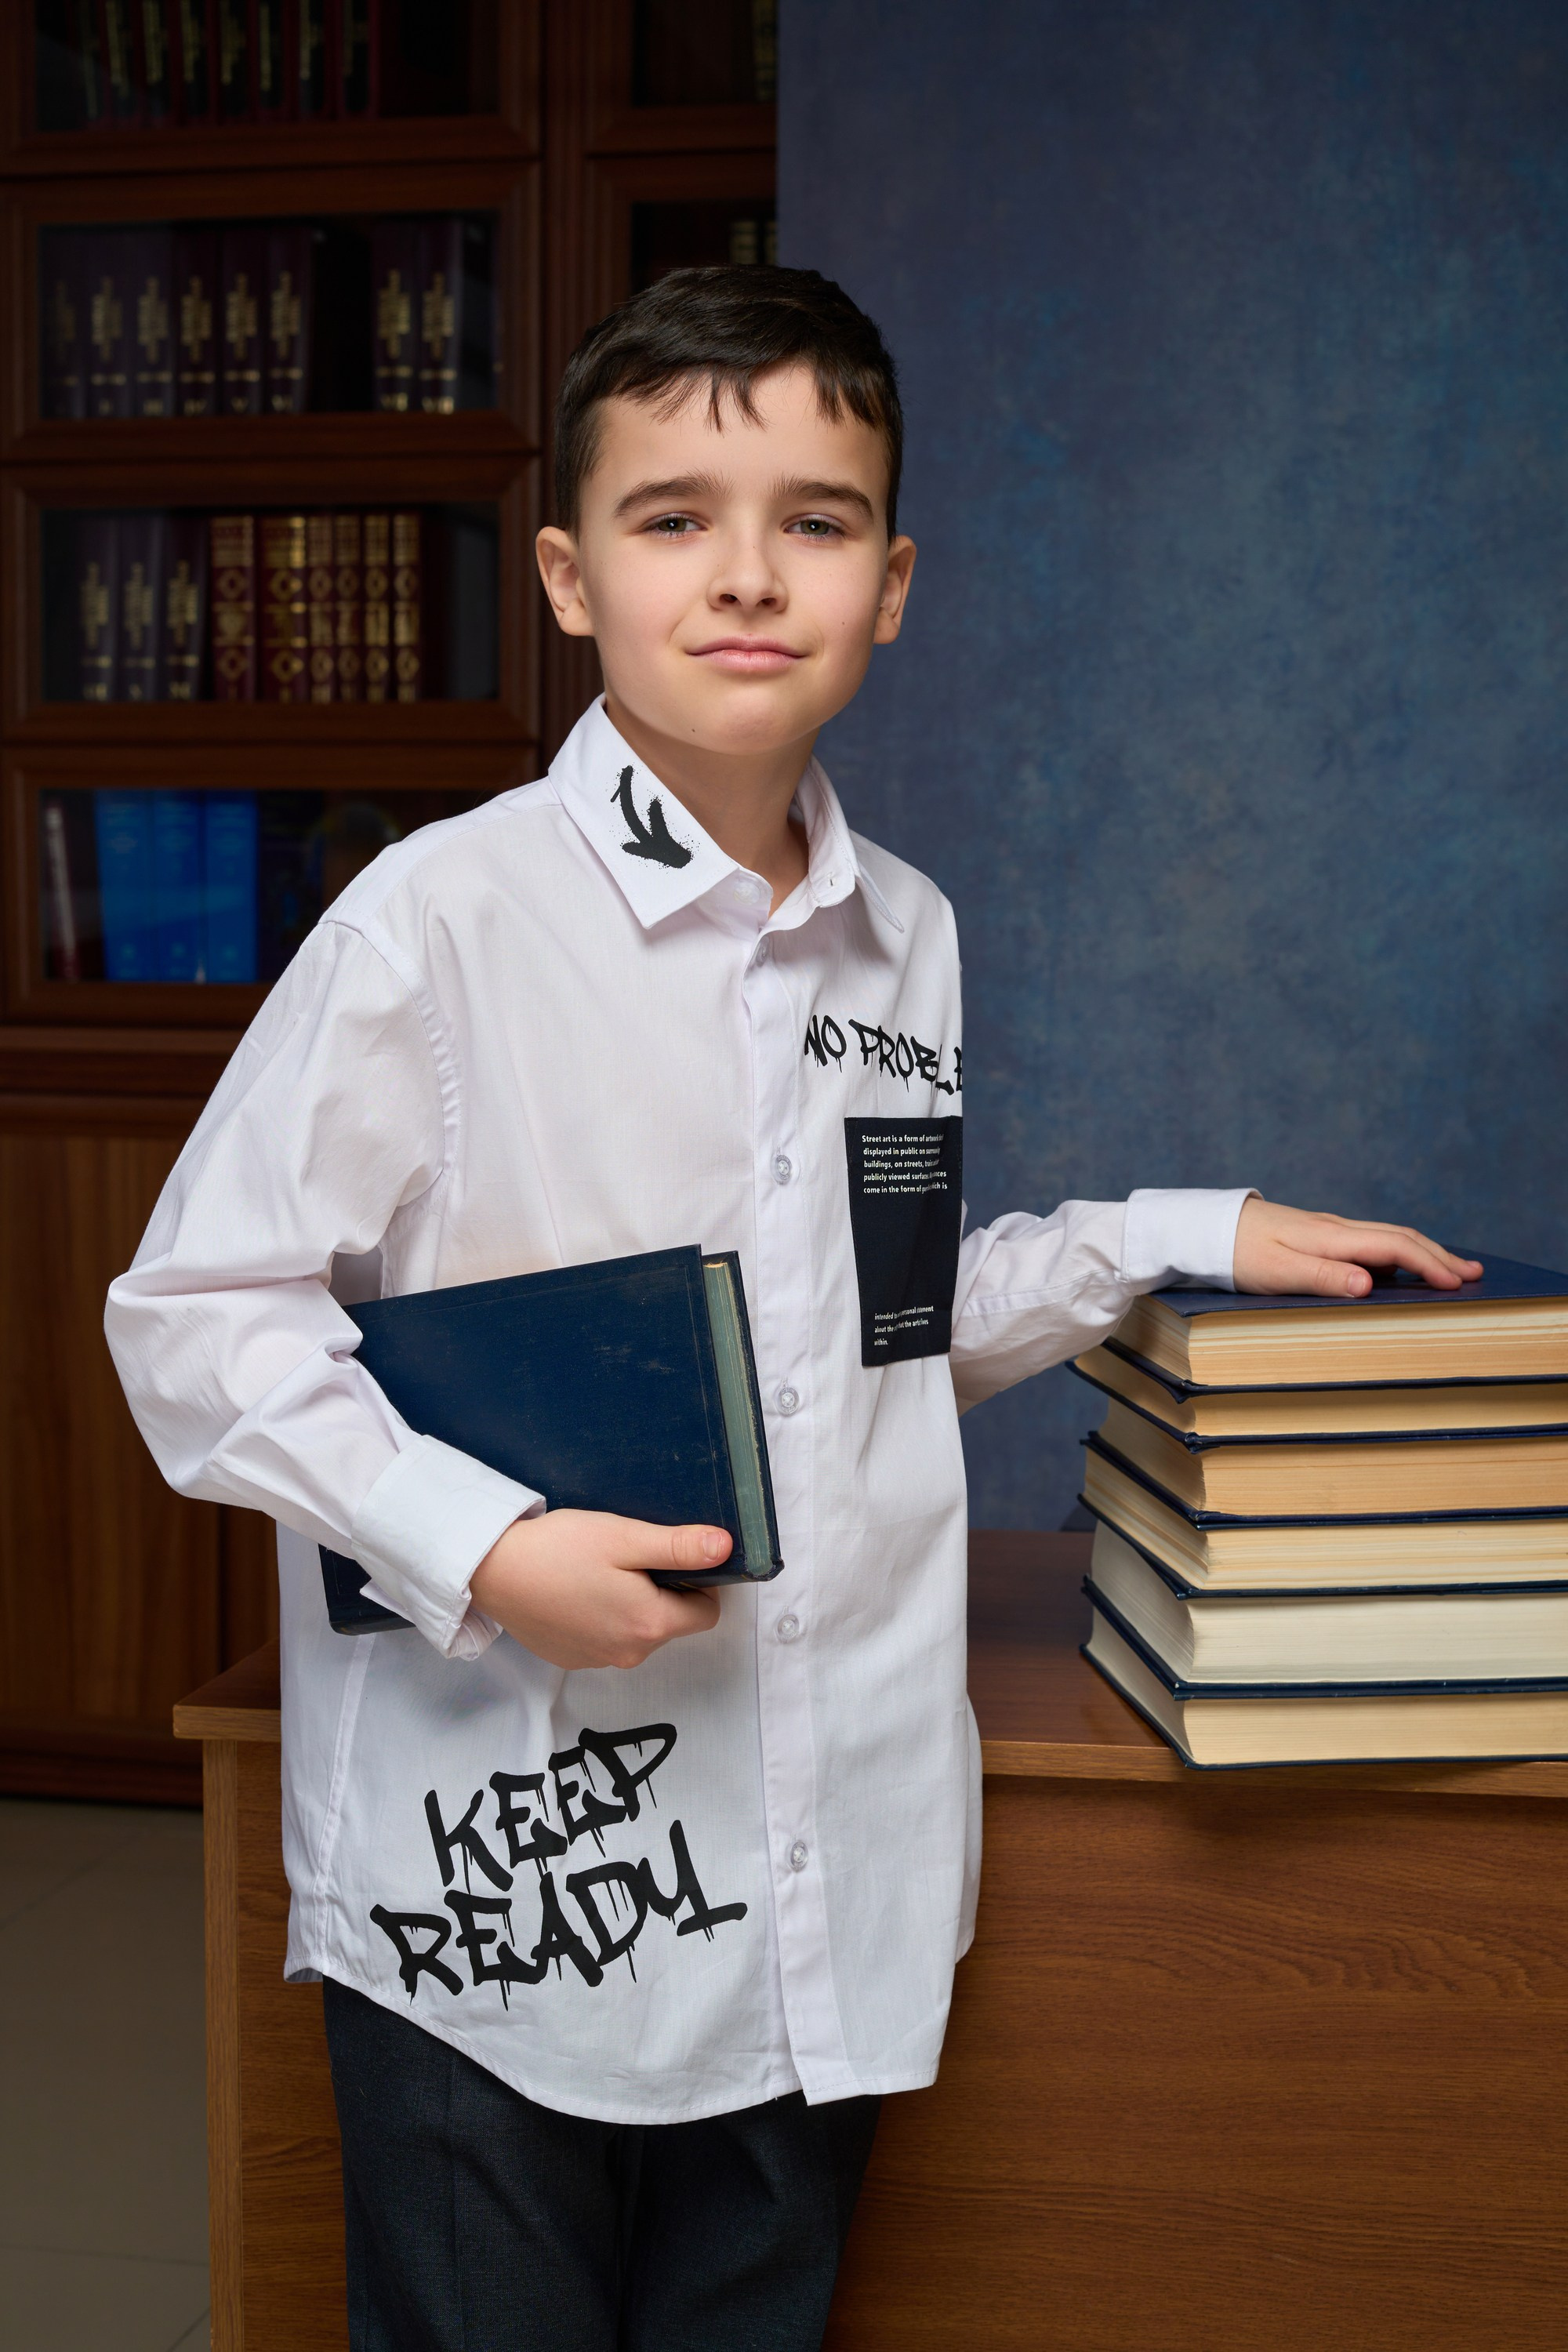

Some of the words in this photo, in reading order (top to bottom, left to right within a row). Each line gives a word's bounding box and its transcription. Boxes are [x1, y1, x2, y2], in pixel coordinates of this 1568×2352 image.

[804, 1014, 847, 1072] NO
[863, 1148, 891, 1156] displayed
[900, 1147, 918, 1156] public
[864, 1160, 893, 1170] buildings,
[863, 1173, 887, 1182] publicly
[888, 1172, 910, 1181] viewed
[874, 1324, 887, 1334] about
[424, 1723, 677, 1893] KEEP
[370, 1820, 748, 2010] READY
